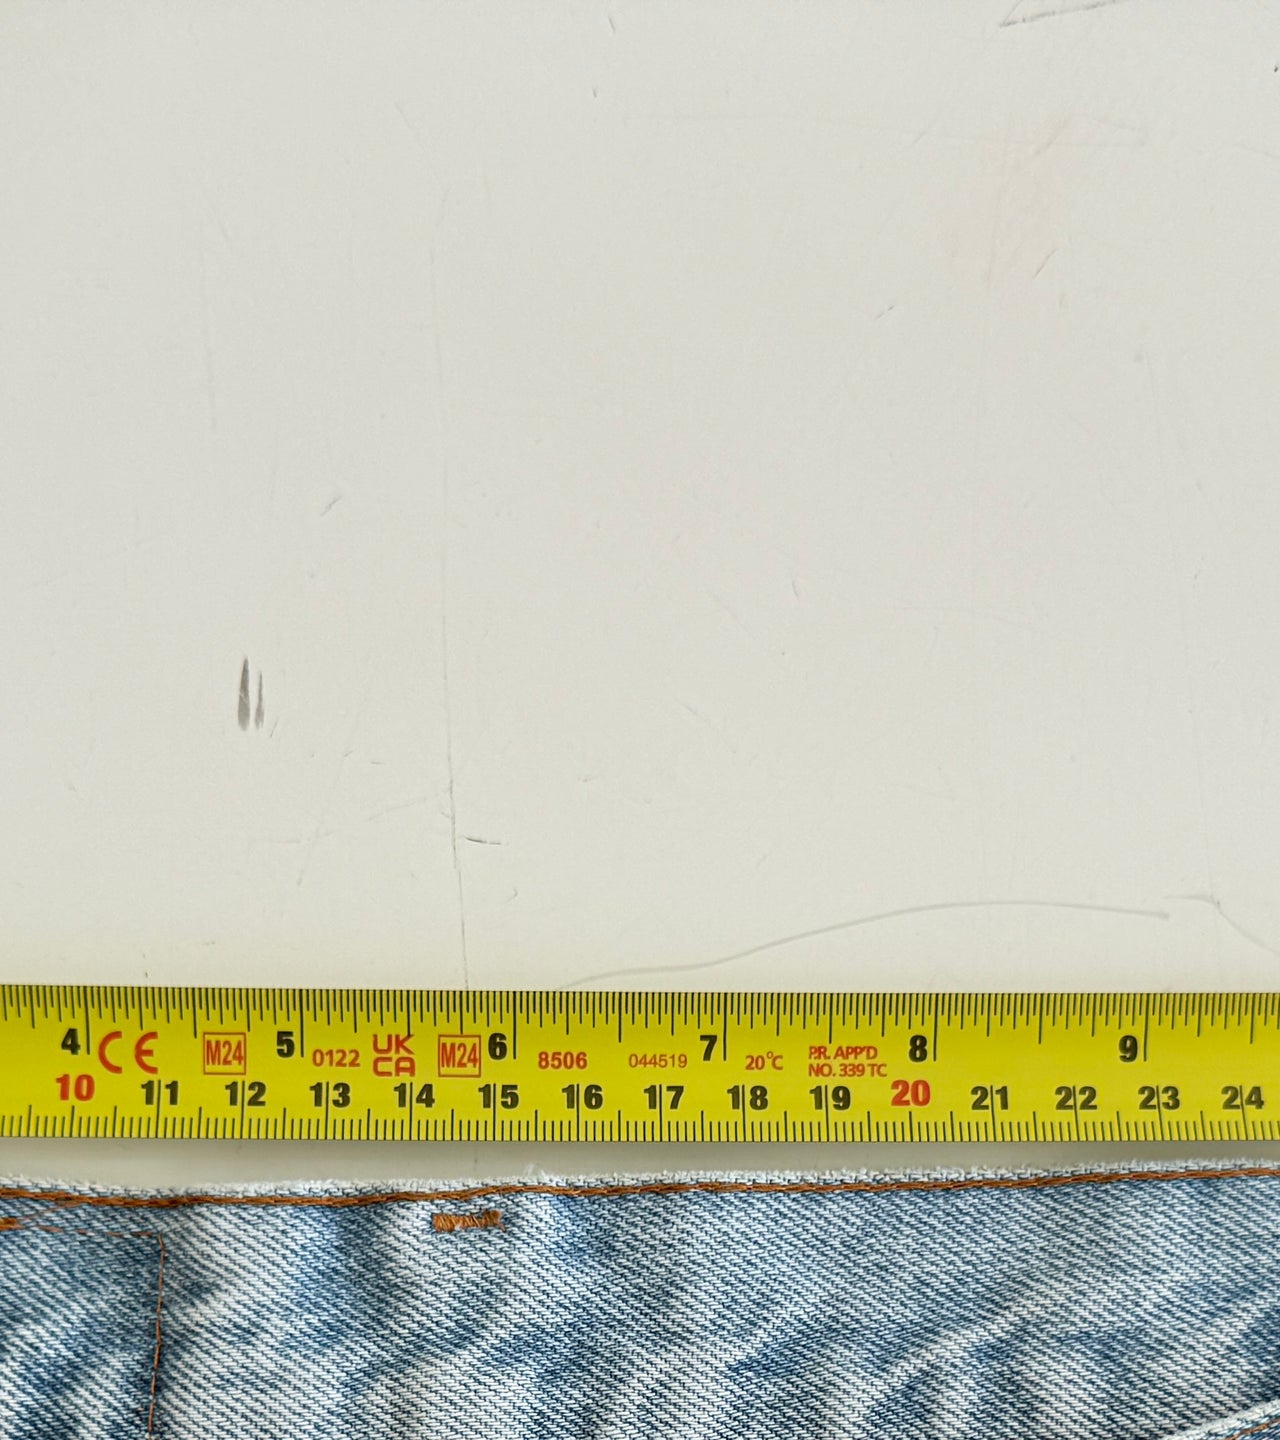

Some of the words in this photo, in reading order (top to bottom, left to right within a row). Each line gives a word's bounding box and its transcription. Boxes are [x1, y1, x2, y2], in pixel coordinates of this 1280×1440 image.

[61, 1028, 81, 1055] 4
[276, 1031, 295, 1058] 5
[488, 1032, 508, 1060] 6
[700, 1035, 718, 1062] 7
[908, 1035, 928, 1062] 8
[1119, 1035, 1138, 1062] 9
[98, 1031, 158, 1074] CE
[205, 1039, 245, 1067] M24
[372, 1034, 415, 1055] UK
[312, 1049, 361, 1068] 0122
[440, 1042, 479, 1069] M24
[537, 1051, 588, 1070] 8506
[628, 1053, 688, 1069] 044519
[372, 1056, 416, 1077] CA
[808, 1063, 836, 1077] NO.
[838, 1063, 865, 1077] 339
[866, 1063, 888, 1077] TC
[56, 1074, 95, 1101] 10
[141, 1080, 179, 1106] 11
[224, 1081, 267, 1107] 12
[309, 1082, 351, 1108] 13
[393, 1083, 436, 1109] 14
[478, 1084, 520, 1109] 15
[561, 1084, 603, 1110] 16
[643, 1085, 685, 1110] 17
[726, 1085, 769, 1111] 18
[809, 1085, 852, 1111] 19
[890, 1079, 931, 1107] 20
[970, 1086, 1009, 1111] 21
[1054, 1086, 1098, 1111] 22
[1138, 1086, 1180, 1110] 23
[1220, 1086, 1264, 1110] 24
